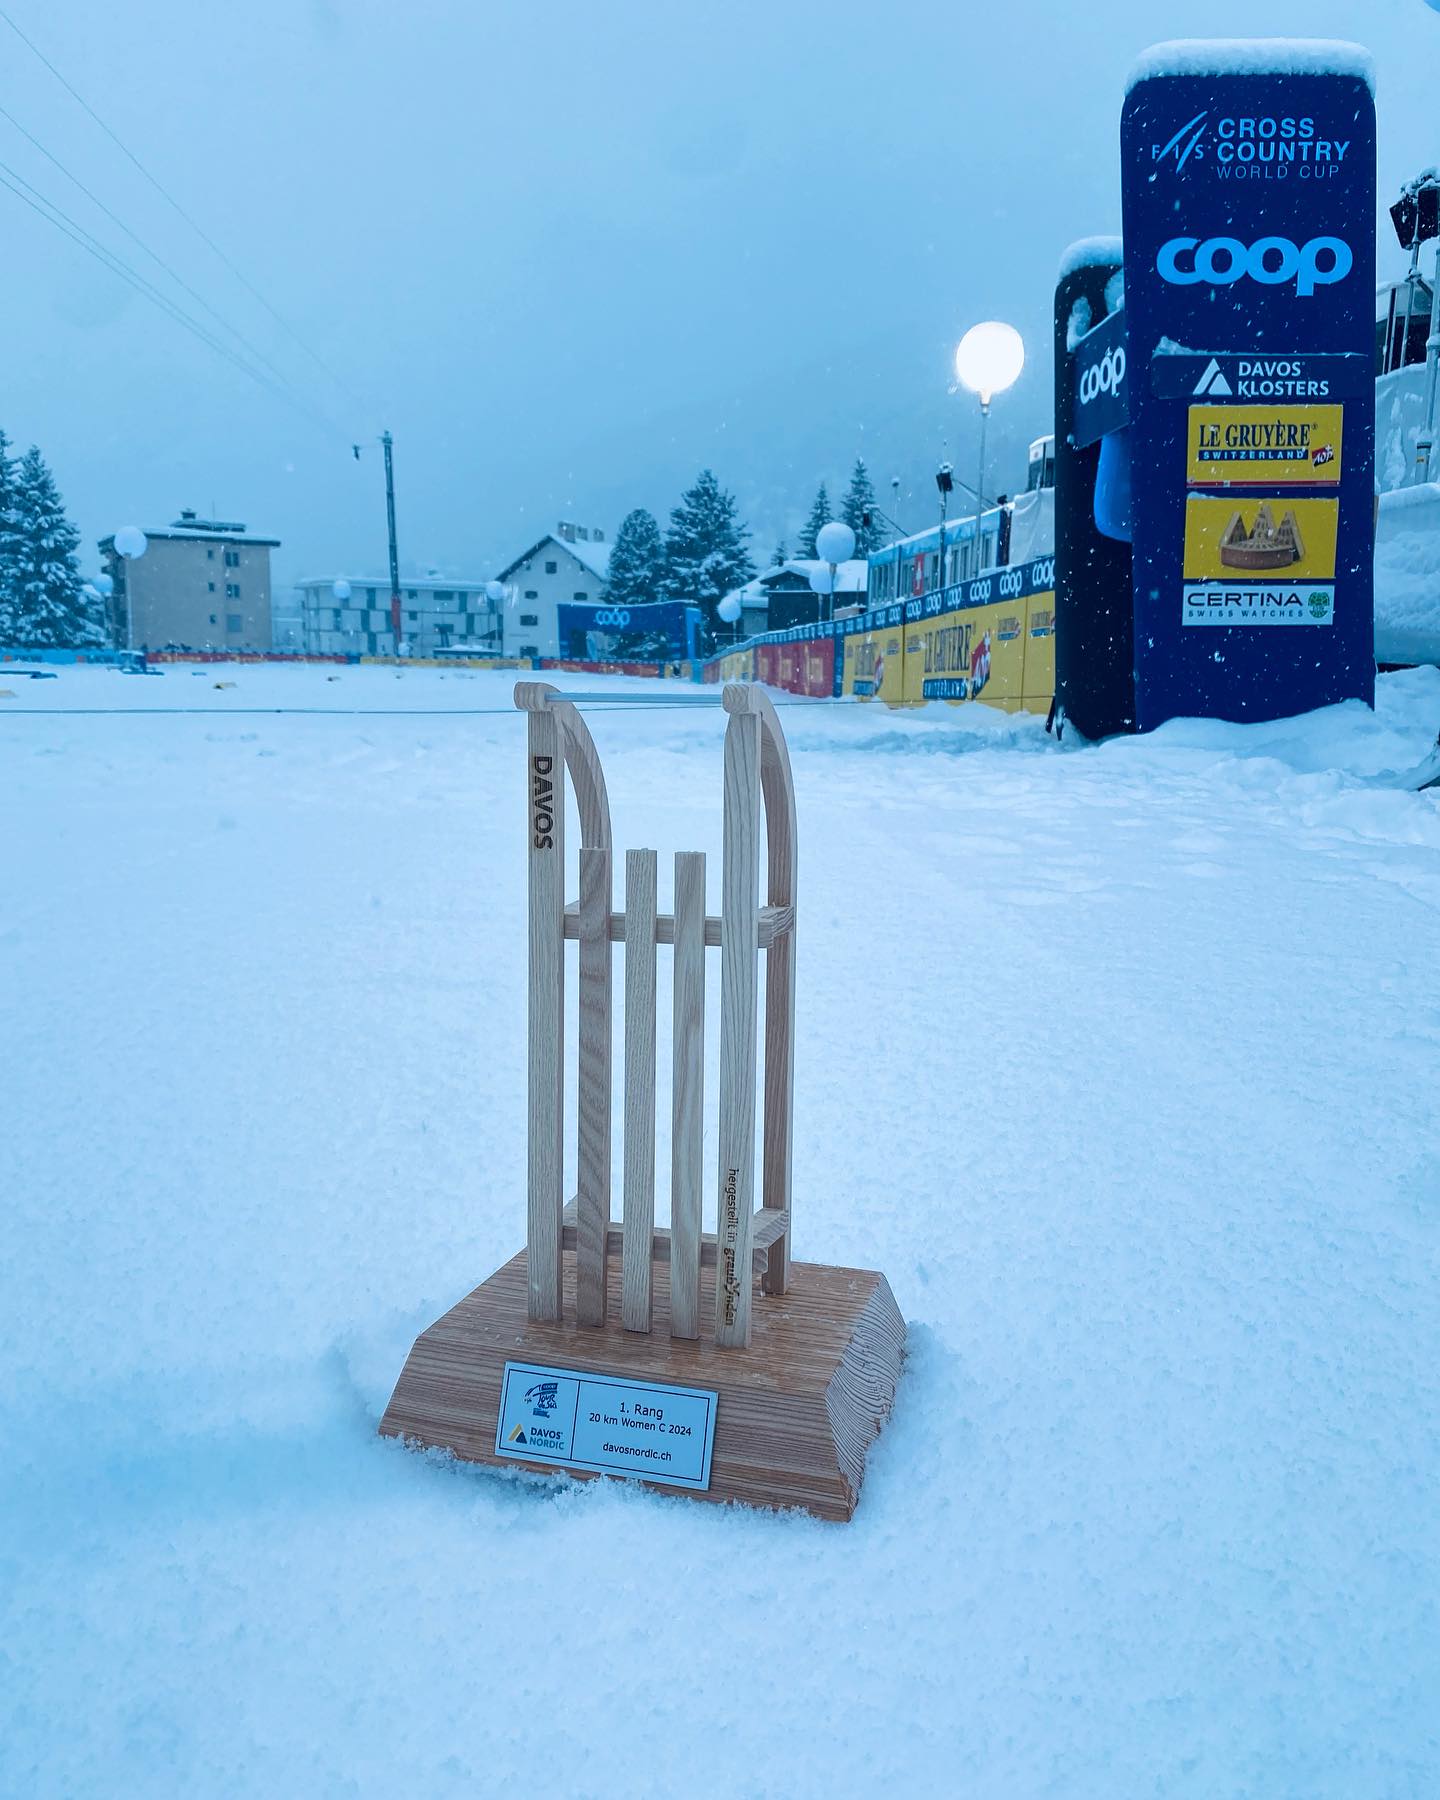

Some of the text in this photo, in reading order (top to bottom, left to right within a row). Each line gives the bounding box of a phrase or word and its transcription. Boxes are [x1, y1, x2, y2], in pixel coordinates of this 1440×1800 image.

[1218, 118, 1315, 139] CROSS
[1217, 141, 1350, 162] COUNTRY
[1216, 165, 1340, 179] WORLD CUP
[1156, 236, 1353, 296] coop
[1080, 346, 1126, 405] coop
[1238, 361, 1302, 377] DAVOS
[1238, 381, 1329, 396] KLOSTERS
[1199, 419, 1310, 447] LE GRUYÈRE
[1203, 450, 1304, 460] SWITZERLAND
[970, 578, 991, 604] coop
[1000, 571, 1022, 598] coop
[1187, 592, 1303, 607] CERTINA
[595, 610, 630, 629] coop
[1188, 609, 1234, 618] SWISS
[1241, 609, 1303, 618] WATCHES
[534, 756, 553, 849] DAVOS
[724, 1168, 739, 1228] hergestellt
[727, 1232, 738, 1243] in
[620, 1402, 664, 1421] 1. Rang
[530, 1427, 561, 1440] DAVOS
[589, 1412, 692, 1437] 20 km Women C 2024
[530, 1436, 565, 1450] NORDIC
[602, 1442, 672, 1461] davosnordic.ch
